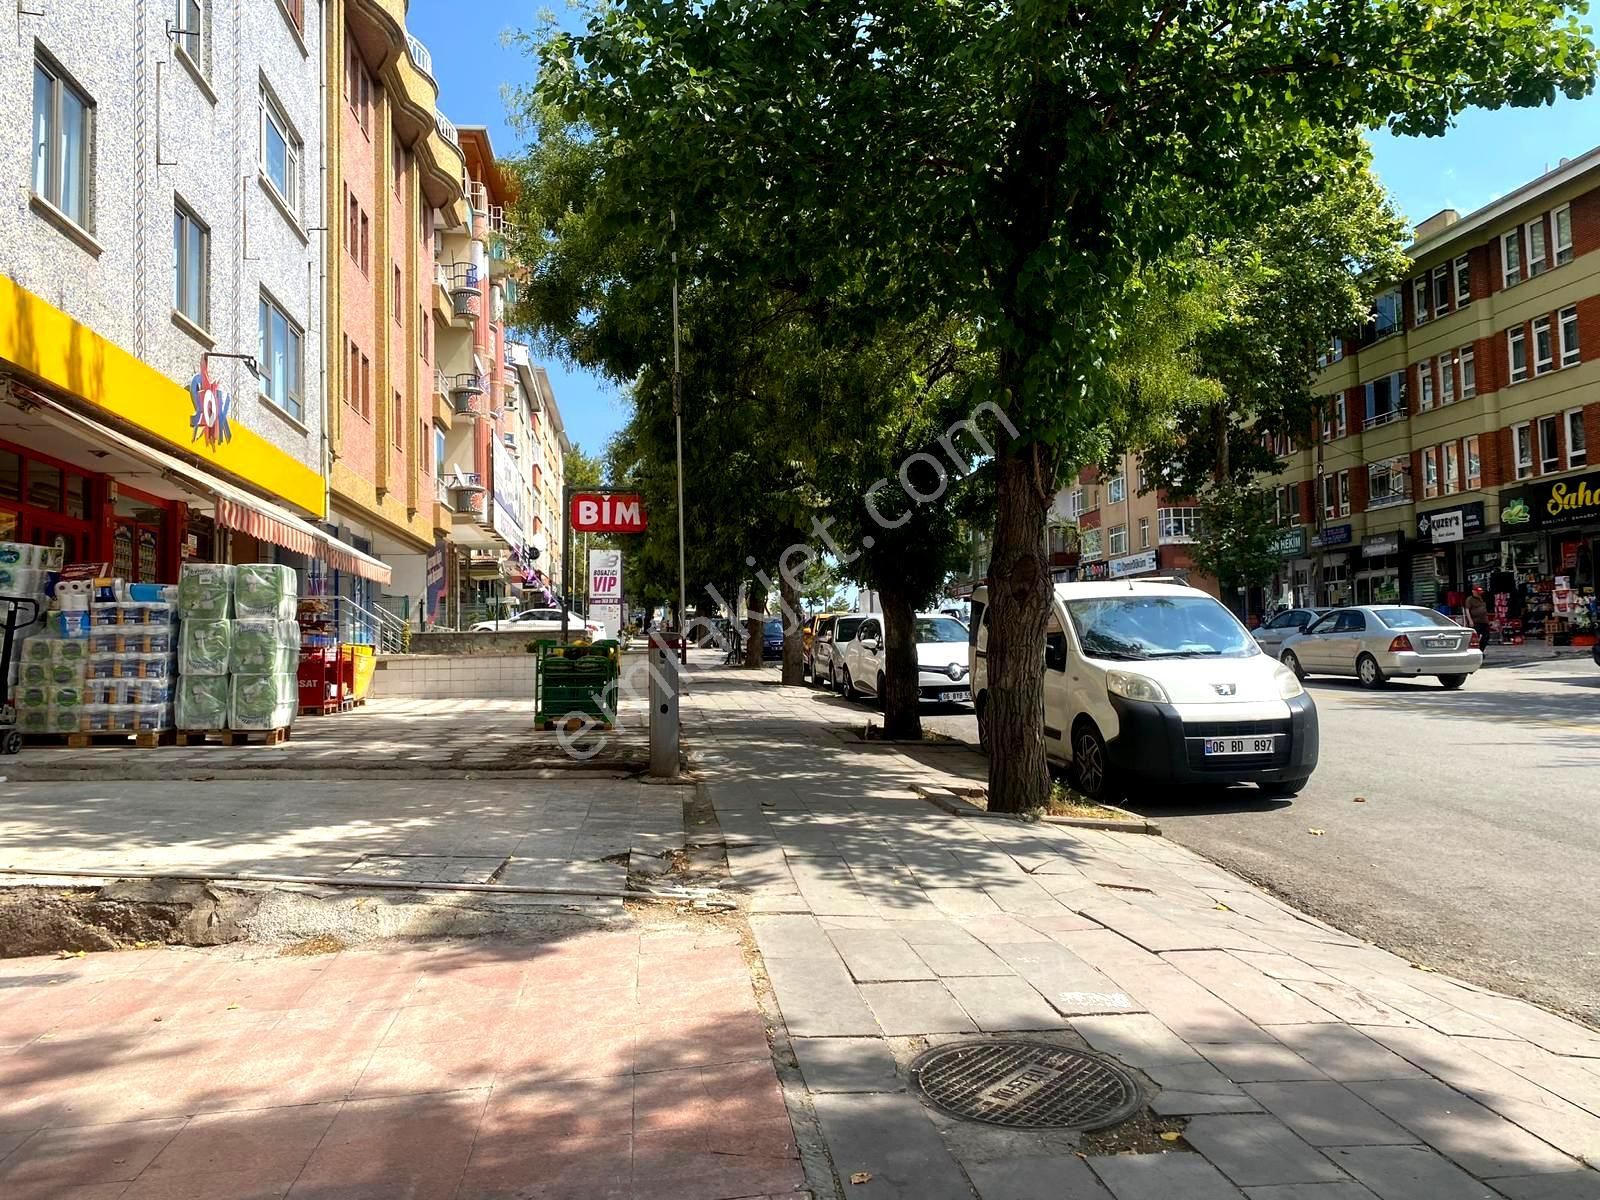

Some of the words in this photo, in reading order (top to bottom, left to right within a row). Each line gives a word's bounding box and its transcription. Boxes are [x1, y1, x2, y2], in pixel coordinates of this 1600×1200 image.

[578, 494, 641, 525] BİM
[593, 576, 617, 592] VIP
[1213, 741, 1225, 753] 06
[1231, 740, 1244, 752] BD
[1254, 740, 1272, 752] 897
